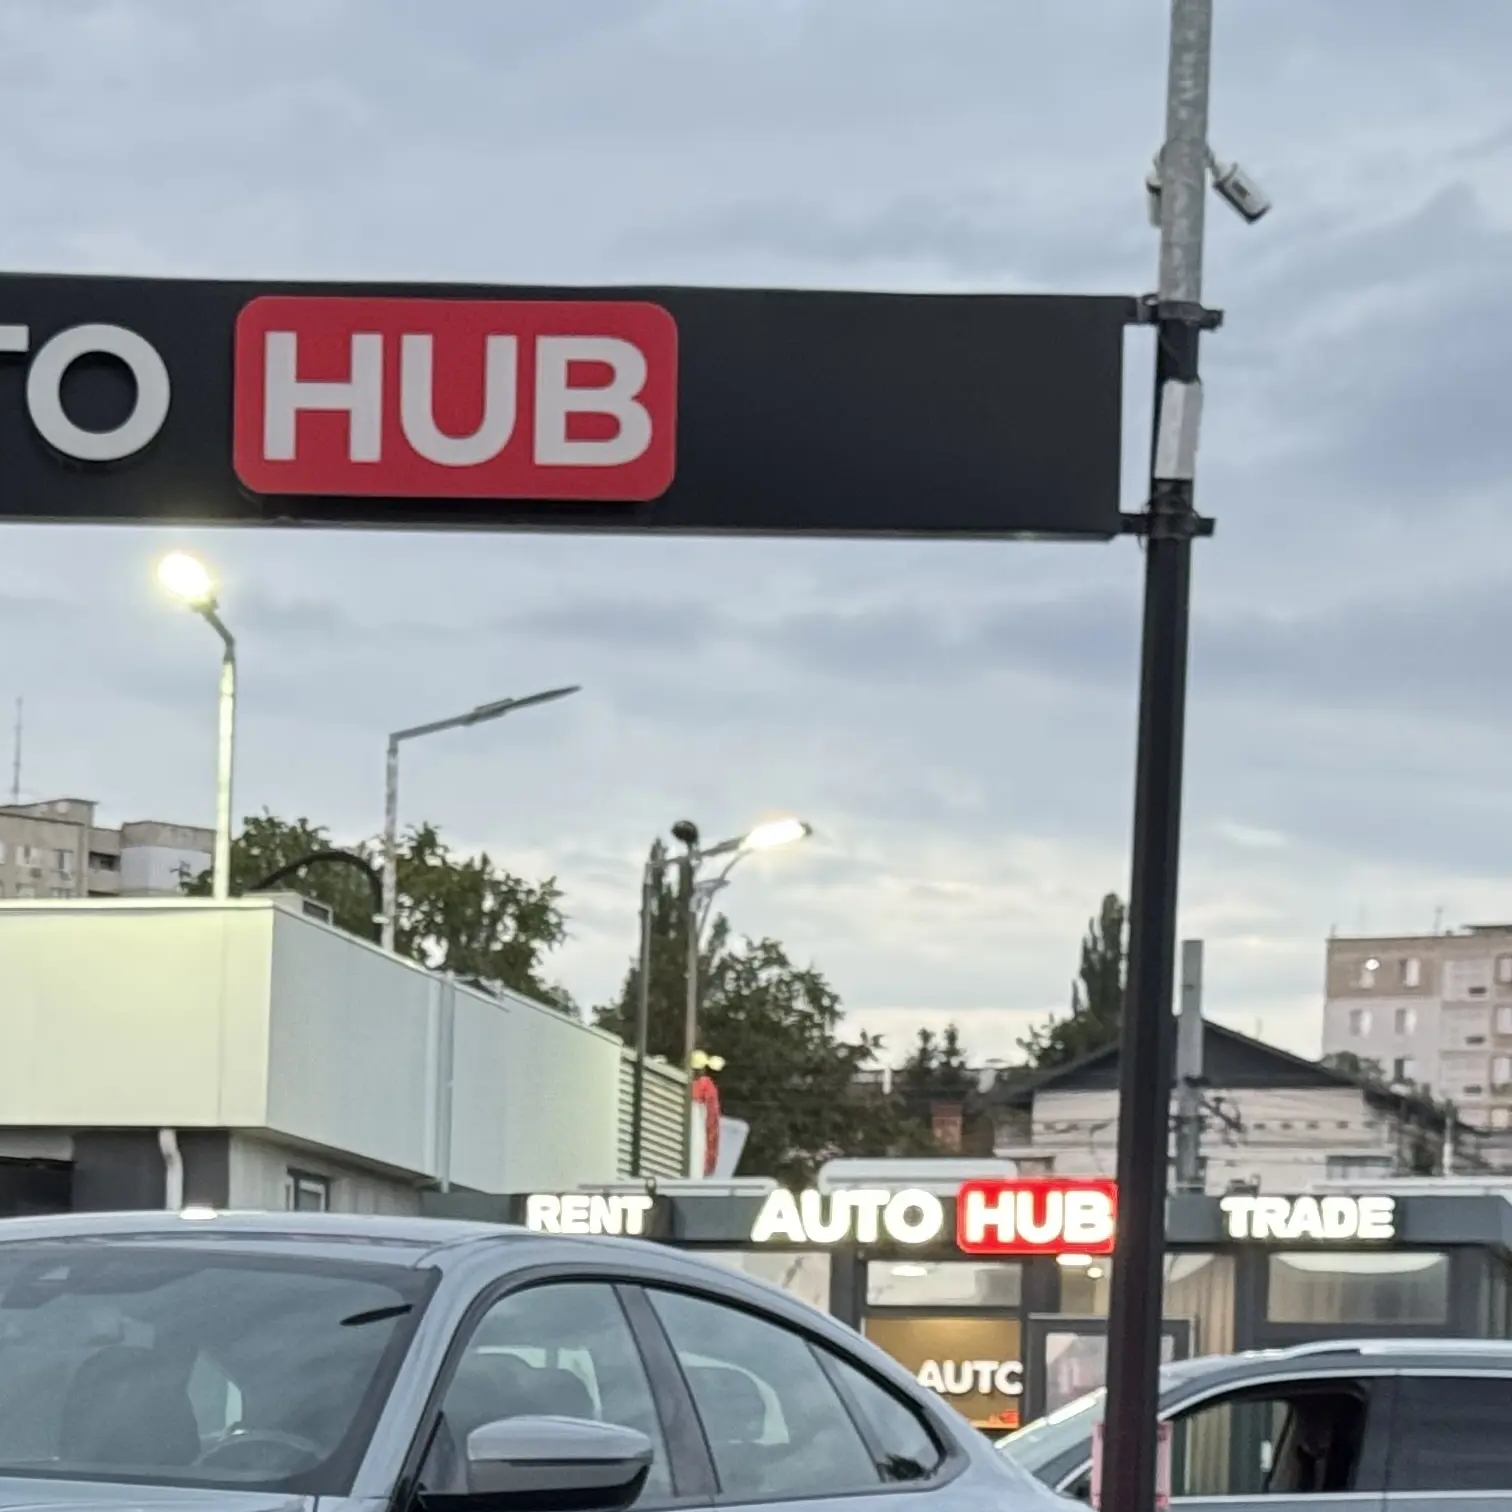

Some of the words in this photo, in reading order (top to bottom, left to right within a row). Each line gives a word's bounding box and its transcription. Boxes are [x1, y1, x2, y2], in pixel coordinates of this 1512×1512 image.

[262, 329, 653, 469] HUB
[525, 1195, 654, 1235] RENT
[750, 1188, 944, 1244] AUTO
[963, 1189, 1116, 1244] HUB
[1219, 1196, 1396, 1239] TRADE
